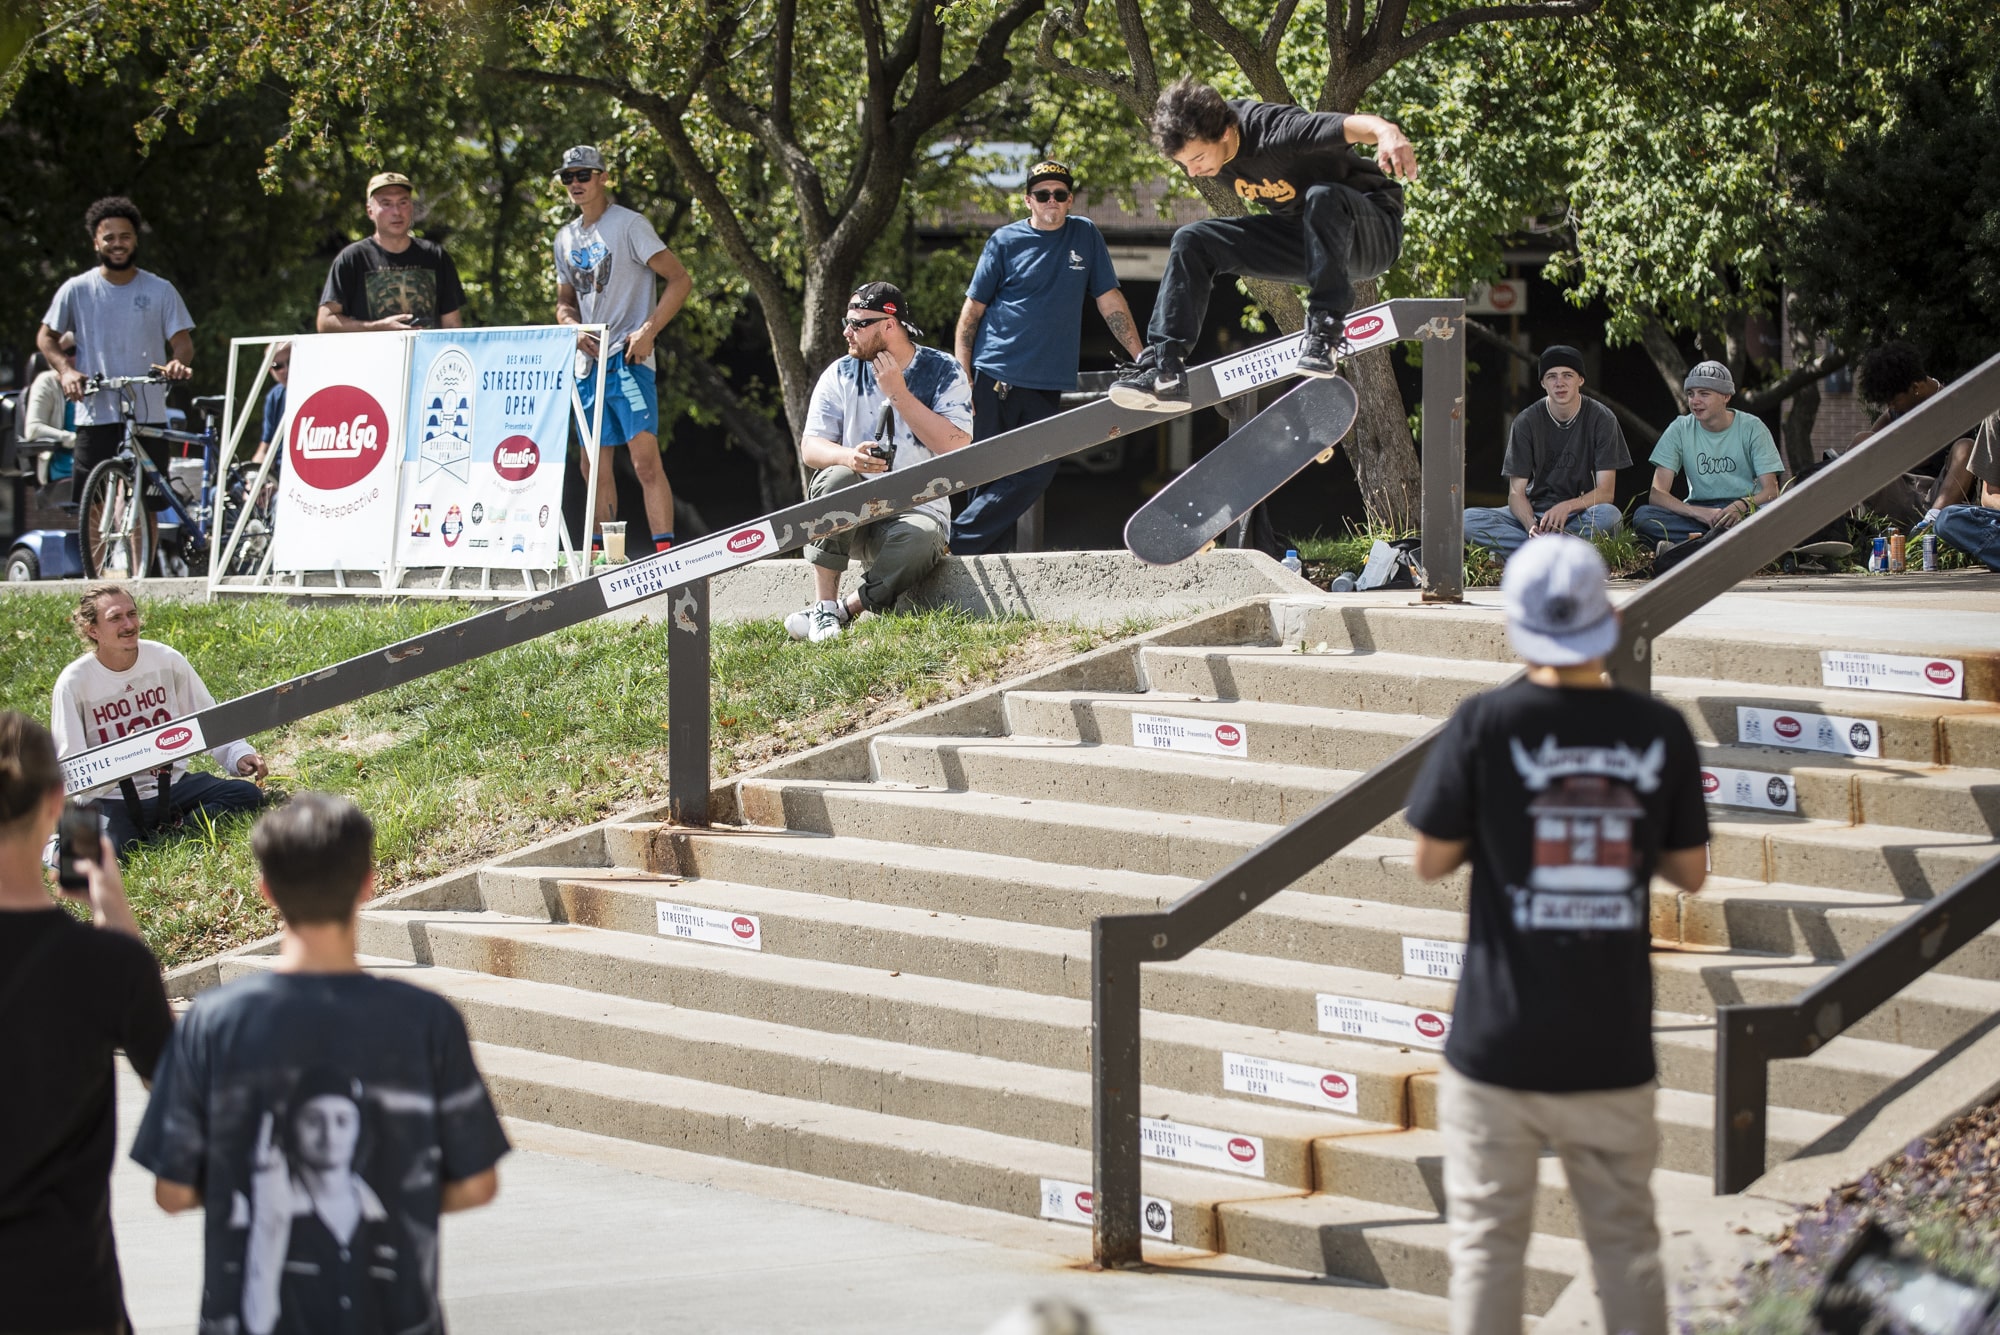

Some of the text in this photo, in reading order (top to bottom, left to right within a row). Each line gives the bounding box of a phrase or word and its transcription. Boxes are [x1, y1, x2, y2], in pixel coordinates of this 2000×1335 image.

[1032, 163, 1067, 176] Coors
[507, 355, 542, 365] DES MOINES
[1224, 348, 1298, 381] STREETSTYLE
[482, 370, 563, 391] STREETSTYLE
[1251, 368, 1279, 385] OPEN
[505, 396, 535, 416] OPEN
[297, 495, 318, 515] Fresh
[320, 486, 380, 519] Perspective
[685, 551, 715, 566] Presented
[715, 549, 723, 558] by
[627, 560, 658, 575] DES MOINES
[610, 561, 682, 593] STREETSTYLE
[636, 580, 664, 596] OPEN
[93, 699, 132, 726] HOO
[136, 686, 167, 710] HOO
[1139, 723, 1185, 738] STREETSTYLE
[1154, 737, 1171, 748] OPEN
[115, 748, 144, 763] Presented
[144, 746, 151, 755] by
[67, 776, 94, 793] OPEN
[662, 911, 704, 927] STREETSTYLE
[676, 925, 692, 937] OPEN
[1428, 964, 1448, 976] OPEN
[1324, 1006, 1379, 1023] STREETSTYLE
[1342, 1022, 1363, 1034] OPEN
[1230, 1064, 1284, 1084] STREETSTYLE
[1248, 1080, 1268, 1093] OPEN
[1140, 1129, 1192, 1148] TREETSTYLE
[1156, 1144, 1176, 1158] OPEN
